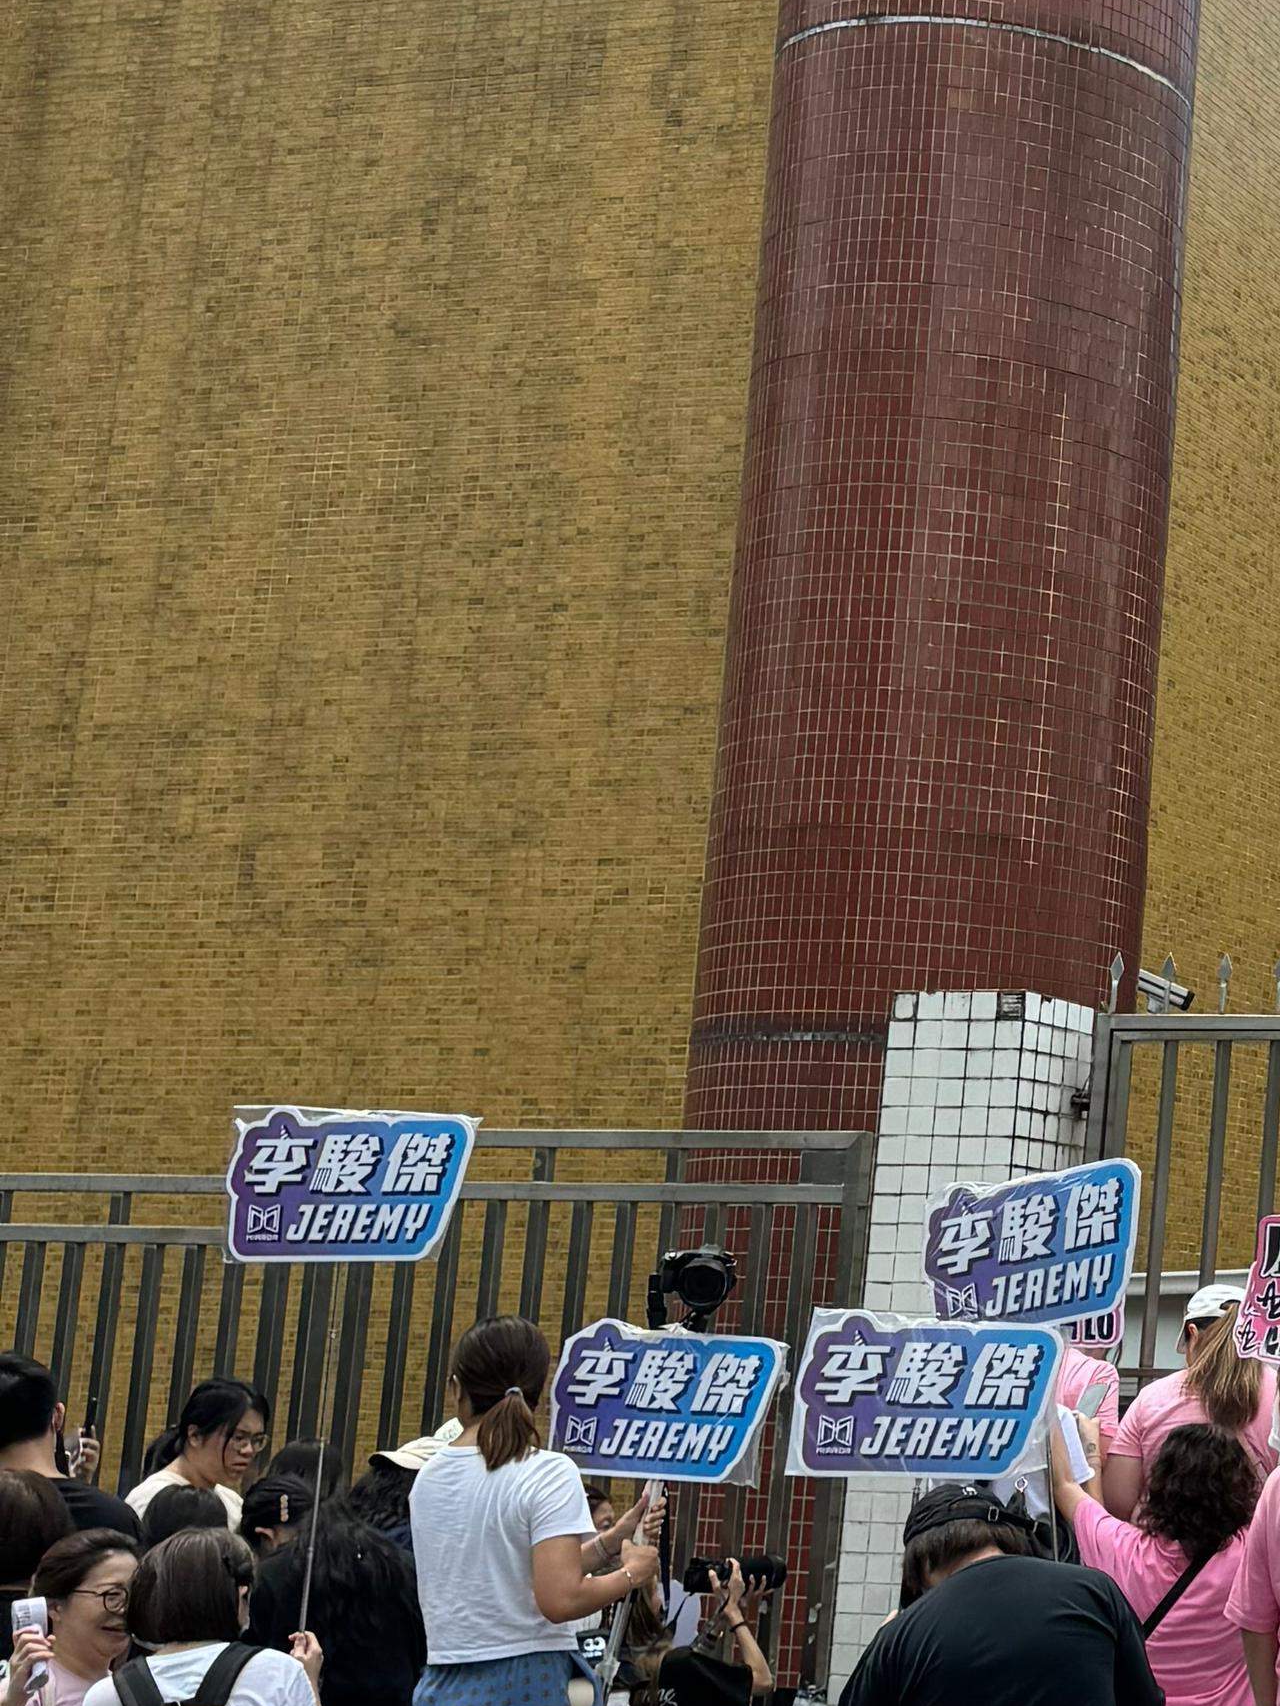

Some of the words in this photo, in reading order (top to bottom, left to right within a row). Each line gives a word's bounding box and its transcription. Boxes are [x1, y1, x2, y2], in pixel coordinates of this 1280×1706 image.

[244, 1133, 453, 1196] 李駿傑
[286, 1203, 432, 1242] JEREMY
[937, 1177, 1123, 1276] 李駿傑
[985, 1253, 1114, 1317] JEREMY
[566, 1349, 762, 1415] 李駿傑
[815, 1342, 1042, 1409] 李駿傑
[599, 1419, 735, 1463] JEREMY
[860, 1416, 1018, 1459] JEREMY
